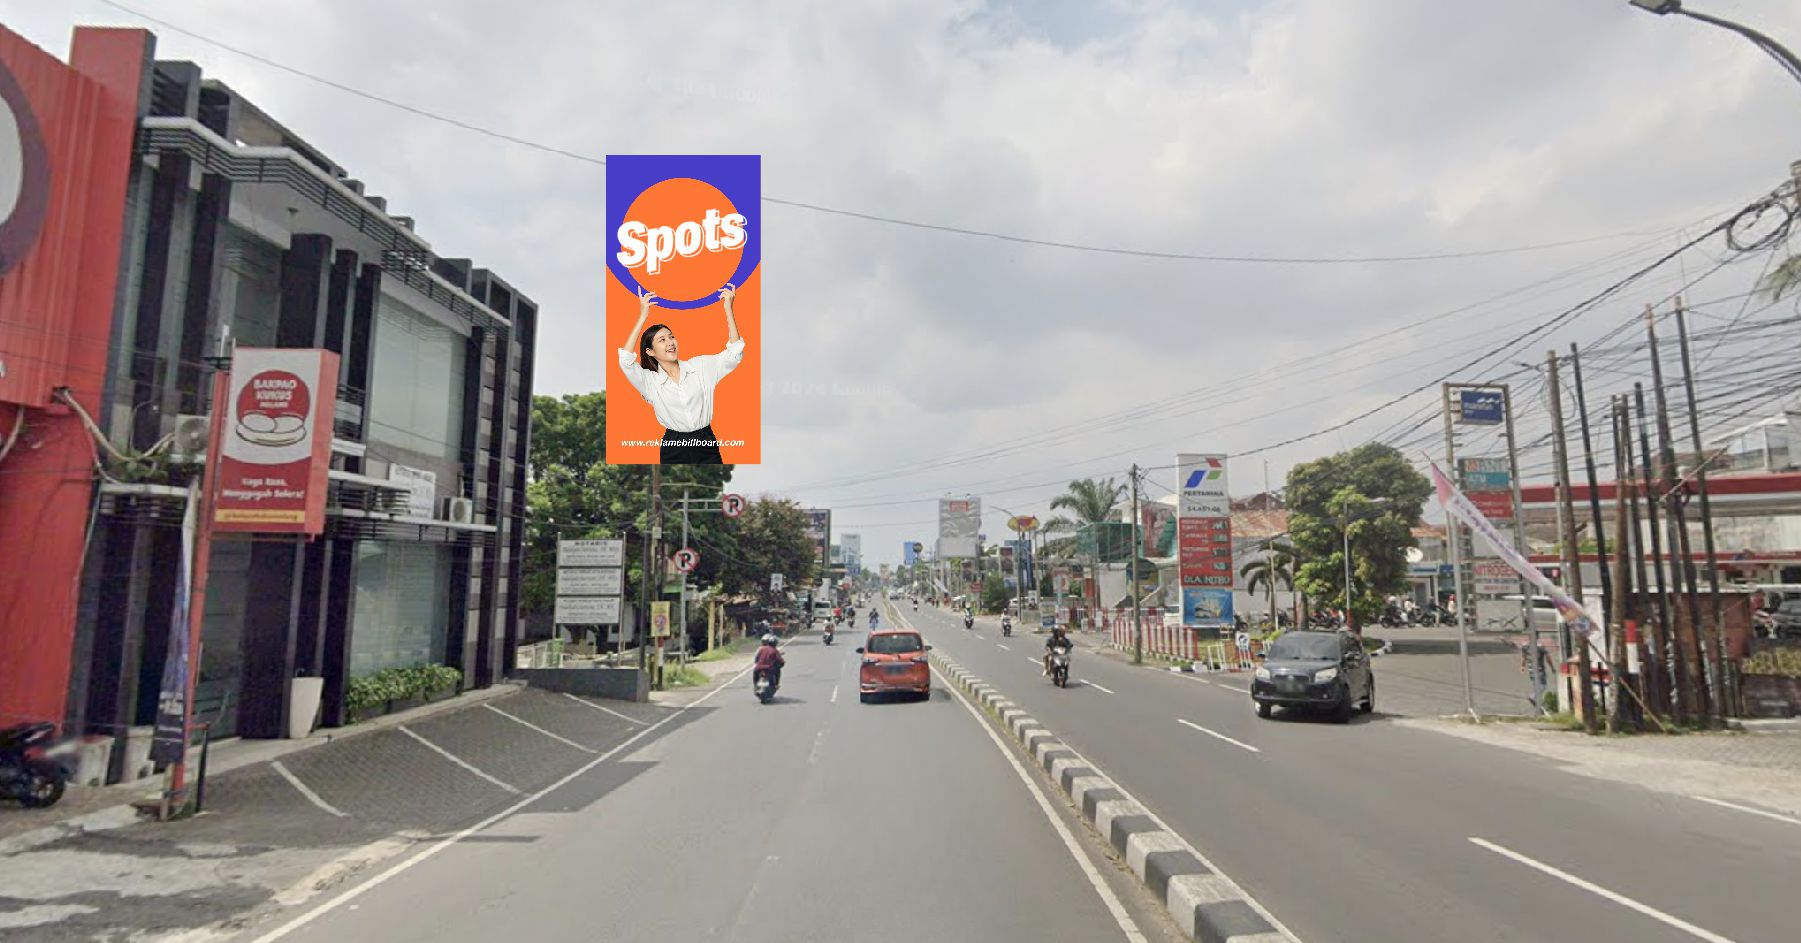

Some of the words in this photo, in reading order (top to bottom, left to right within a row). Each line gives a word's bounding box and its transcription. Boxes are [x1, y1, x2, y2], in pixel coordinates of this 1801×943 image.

[616, 208, 748, 275] Spots
[253, 379, 298, 389] BAKPAO
[256, 390, 292, 400] KUKUS
[621, 438, 744, 447] www.reklamebillboard.com
